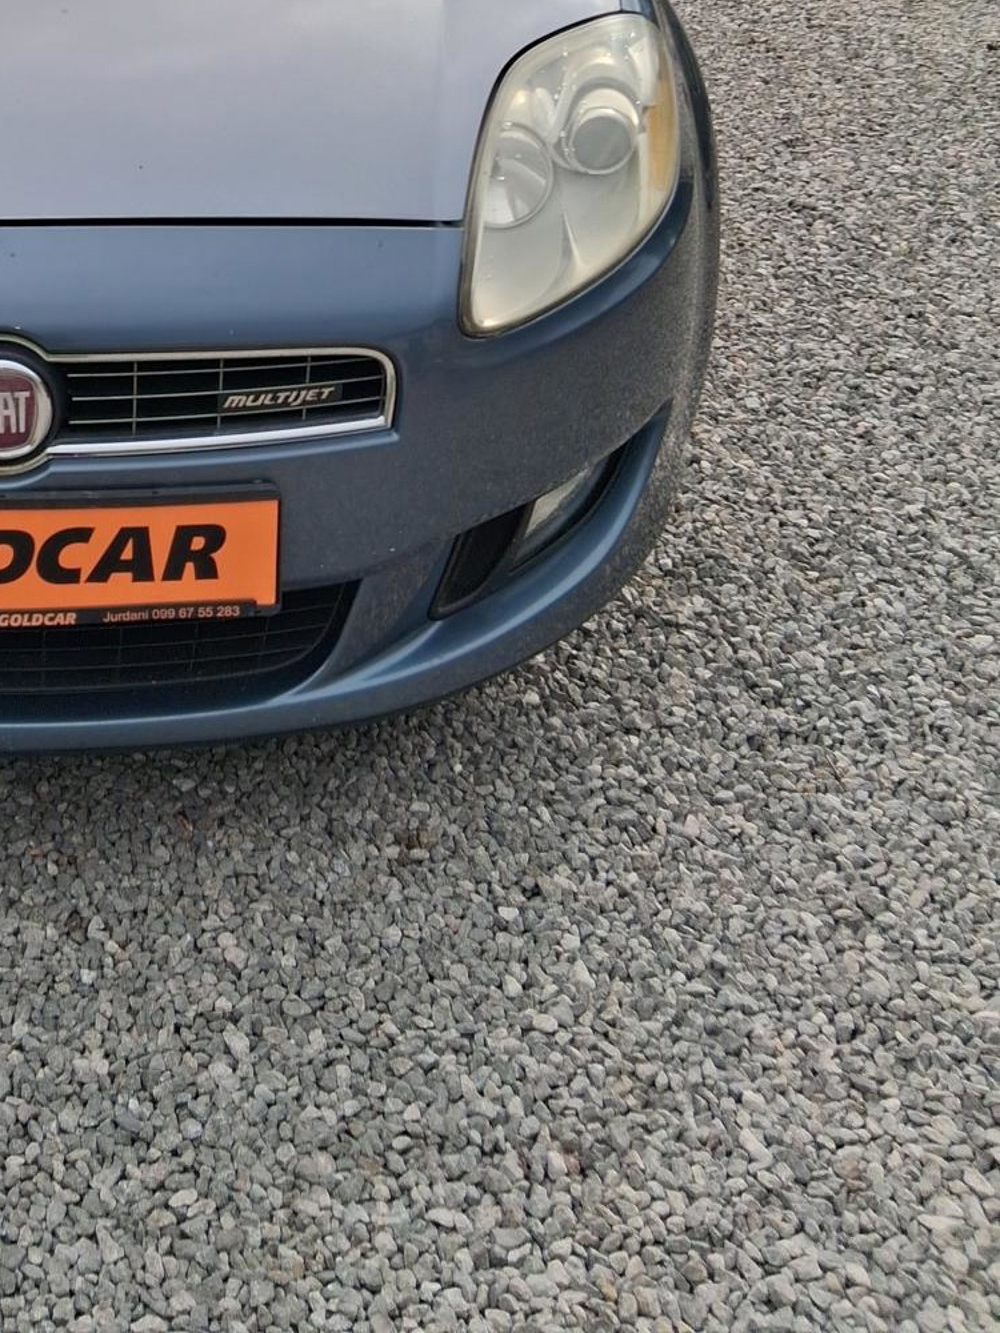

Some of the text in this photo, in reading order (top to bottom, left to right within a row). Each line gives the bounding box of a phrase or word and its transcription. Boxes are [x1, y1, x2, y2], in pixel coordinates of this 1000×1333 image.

[223, 387, 335, 408] MULTIJET
[102, 605, 241, 623] Jurdani 099 67 55 283
